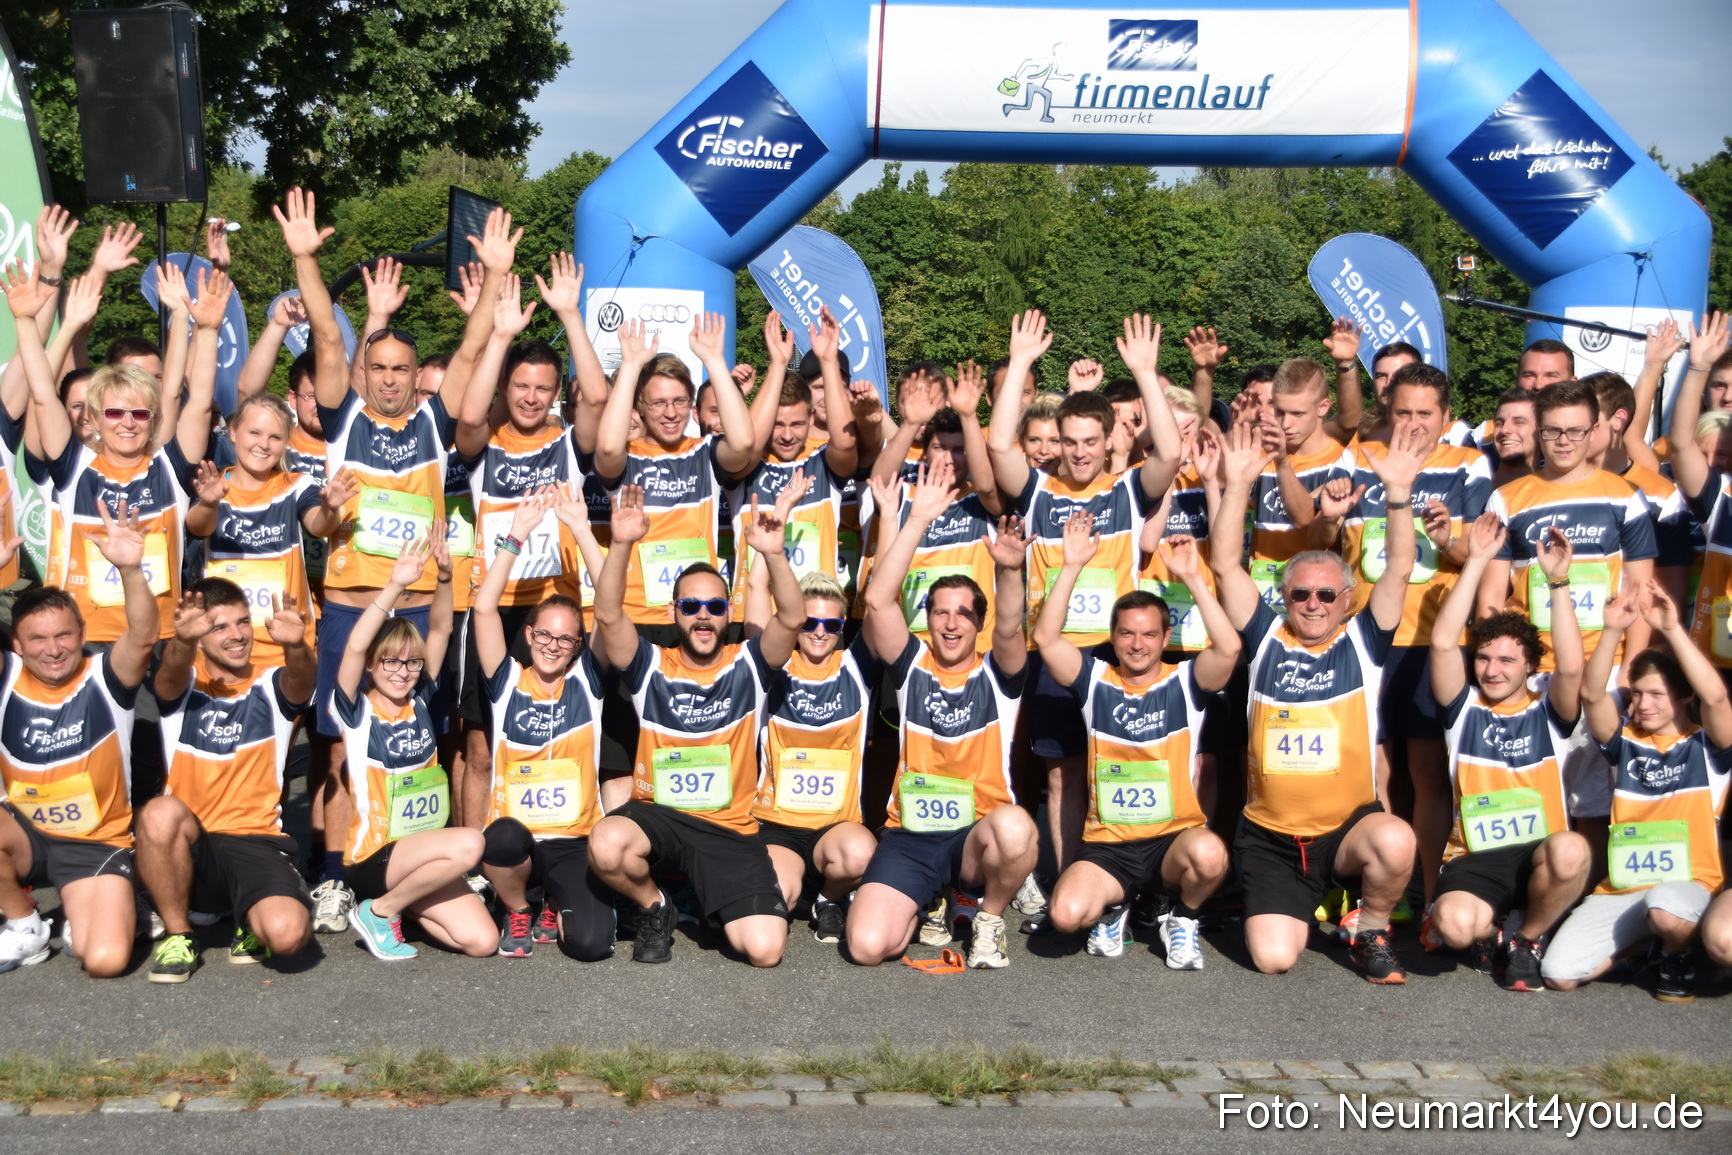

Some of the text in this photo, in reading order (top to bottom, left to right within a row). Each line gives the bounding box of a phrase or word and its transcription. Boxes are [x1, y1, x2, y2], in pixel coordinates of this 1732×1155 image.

[1074, 73, 1274, 109] firmenlauf
[1072, 112, 1154, 124] neumarkt
[698, 133, 803, 159] Fischer
[1488, 144, 1519, 160] und
[706, 157, 793, 170] AUTOMOBILE
[370, 515, 417, 542] 428
[678, 697, 732, 717] Fische
[1276, 733, 1324, 756] 414
[669, 772, 716, 794] 397
[791, 773, 835, 796] 395
[402, 793, 440, 820] 420
[520, 786, 567, 809] 465
[915, 798, 960, 820] 396
[1111, 787, 1157, 809] 423
[32, 802, 82, 824] 458
[1473, 813, 1537, 843] 1517
[1624, 849, 1674, 873] 445
